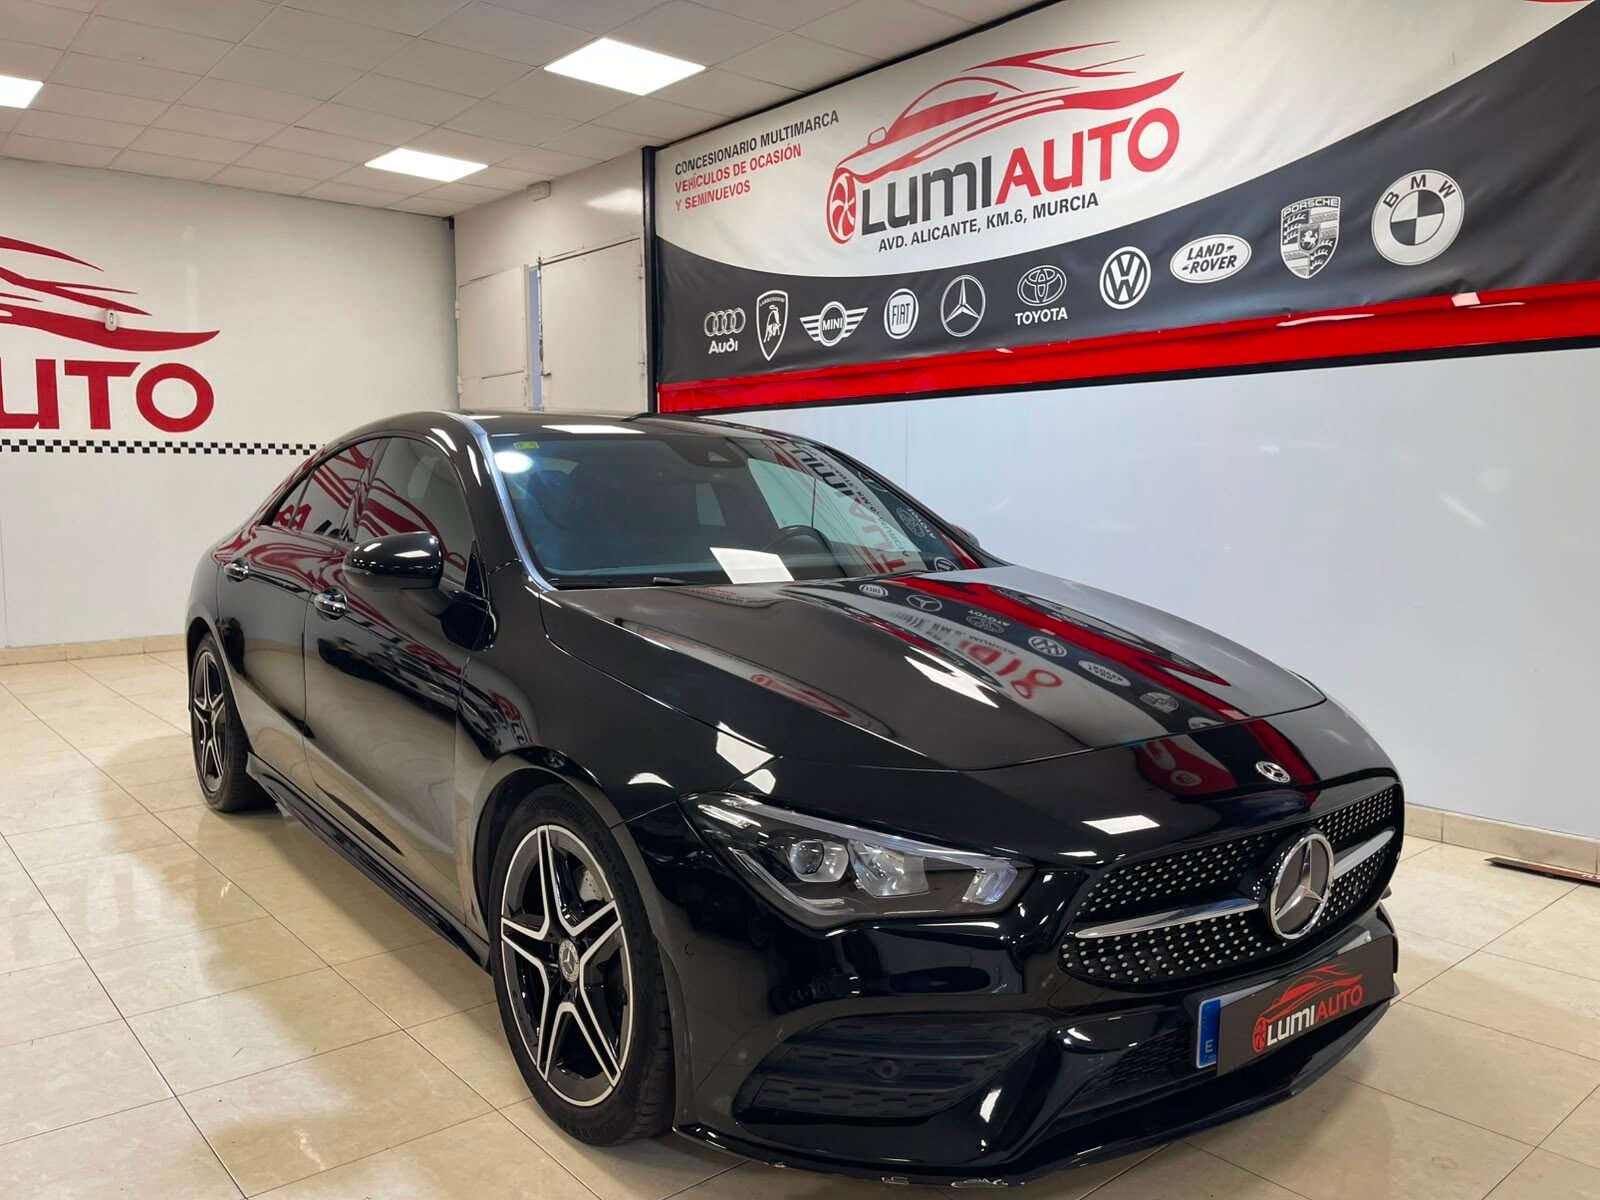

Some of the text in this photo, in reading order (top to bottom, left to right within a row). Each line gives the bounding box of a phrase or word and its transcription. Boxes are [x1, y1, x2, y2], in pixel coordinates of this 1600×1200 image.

[675, 110, 839, 176] CONCESIONARIO MULTIMARCA
[675, 143, 802, 193] VEHÍCULOS DE OCASIÓN
[675, 180, 751, 211] Y SEMINUEVOS
[1383, 174, 1456, 209] BMW
[1283, 197, 1339, 217] PORSCHE
[878, 192, 1098, 252] AVD. ALICANTE, KM.6, MURCIA
[822, 318, 843, 331] MINI
[891, 302, 912, 326] FIAT
[1015, 307, 1068, 326] TOYOTA
[708, 338, 738, 354] Audi
[1204, 1039, 1214, 1053] E
